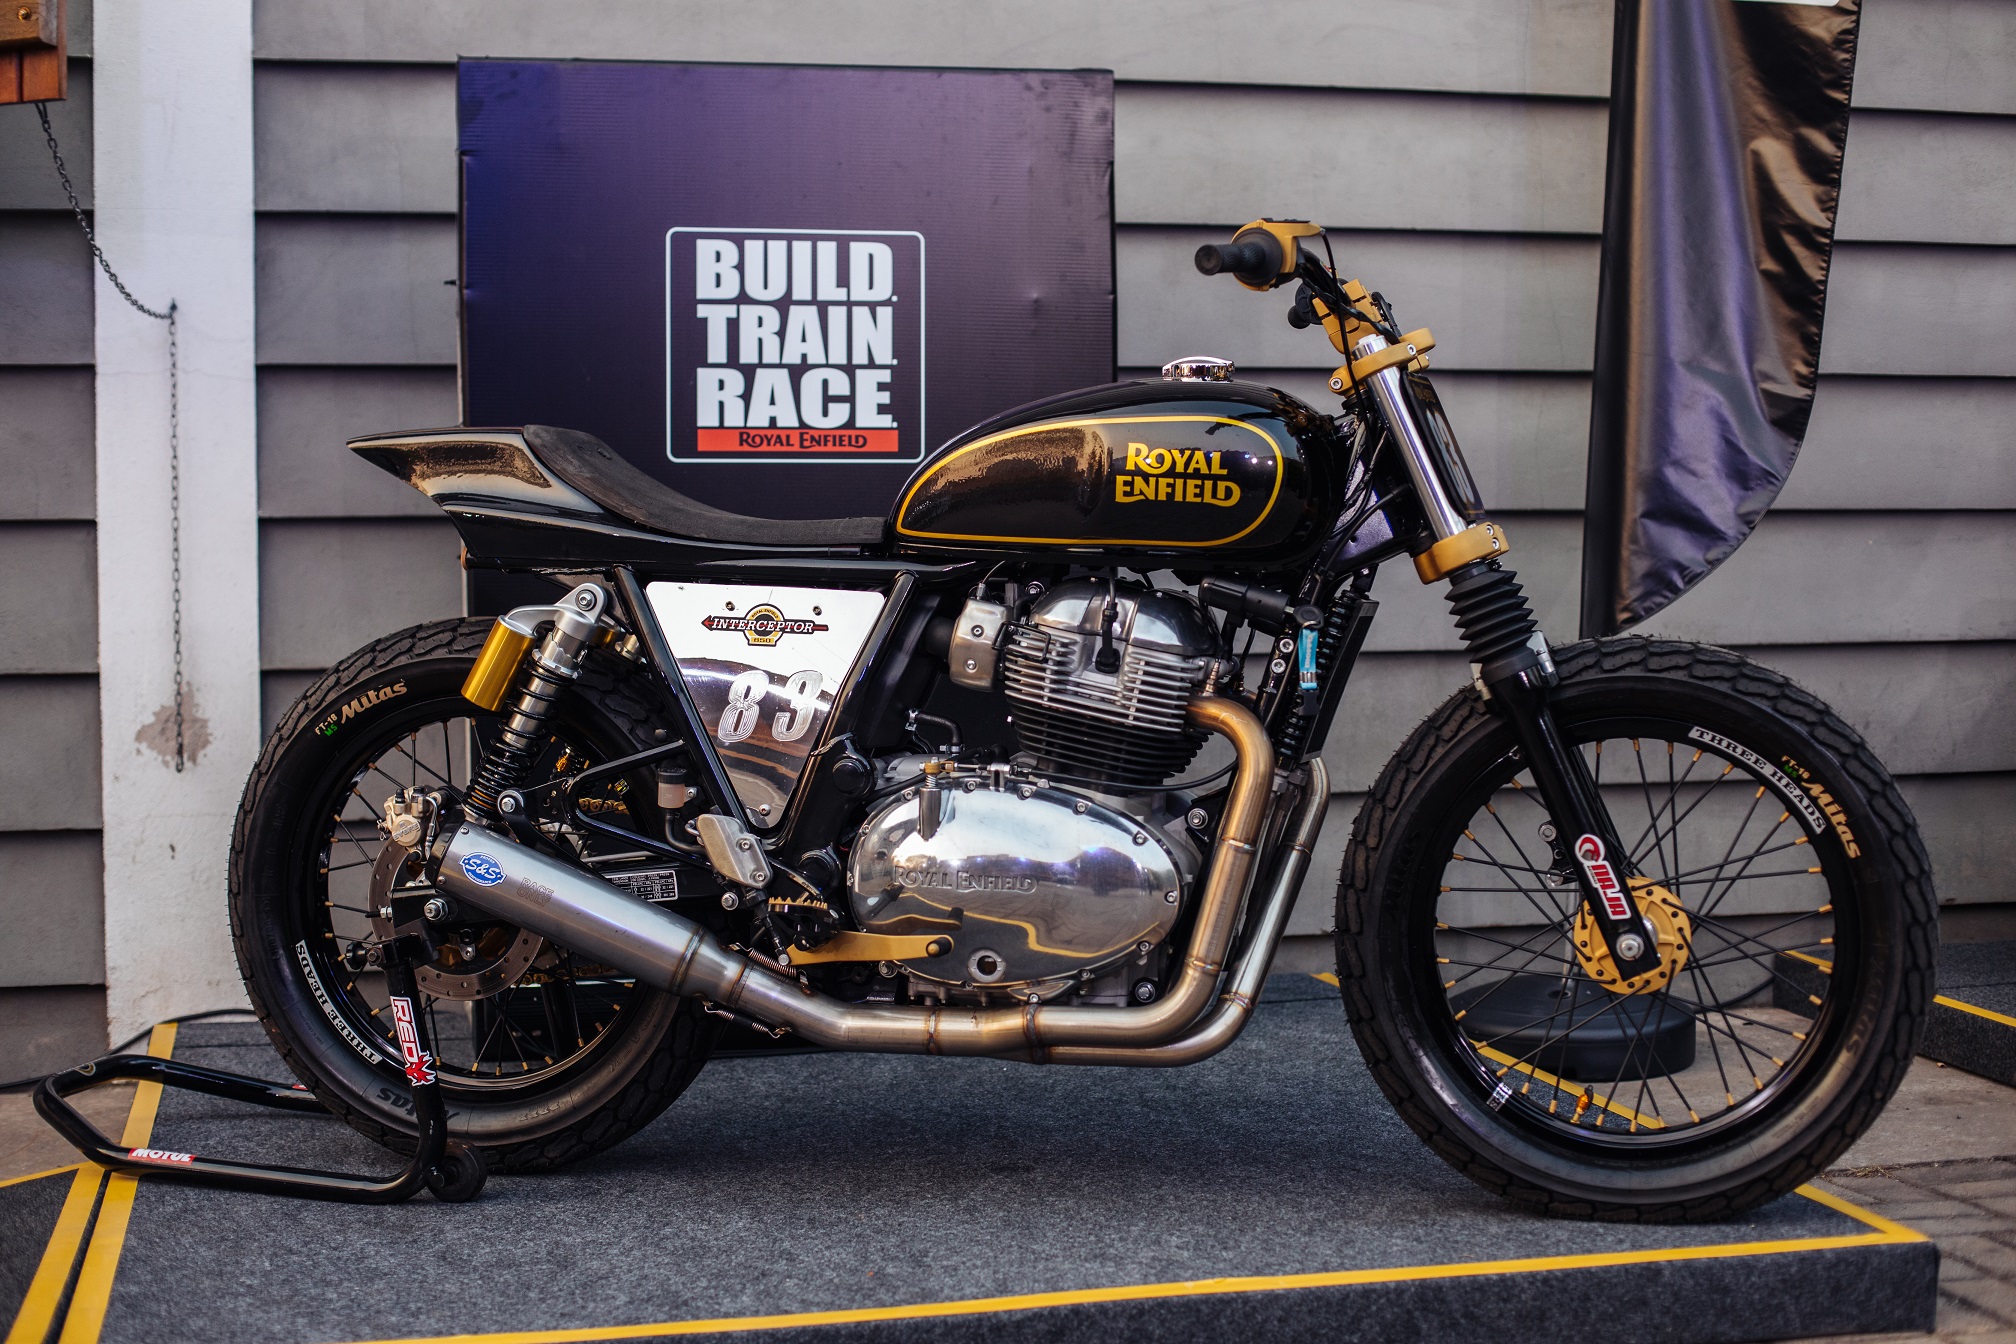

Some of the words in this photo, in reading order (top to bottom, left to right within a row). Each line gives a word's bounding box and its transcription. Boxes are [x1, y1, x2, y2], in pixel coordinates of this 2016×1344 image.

[696, 238, 898, 302] BUILD.
[696, 304, 898, 365] TRAIN.
[696, 367, 898, 429] RACE.
[738, 431, 795, 449] ROYAL
[799, 431, 868, 450] ENFIELD
[1125, 442, 1228, 475] ROYAL
[1115, 475, 1241, 507] ENFIELD
[711, 618, 814, 633] INTERCEPTOR
[341, 680, 408, 724] Mitas
[314, 713, 338, 736] FT-18
[324, 723, 338, 737] MS
[1695, 728, 1768, 770] THREE
[1768, 769, 1826, 830] HEADS
[1781, 755, 1811, 780] FT-18
[1801, 781, 1862, 859] Mitas
[465, 858, 501, 879] S&S
[893, 866, 952, 889] ROYAL
[956, 871, 1038, 894] ENFIELD
[516, 886, 550, 907] ONLY
[521, 877, 554, 898] RACE
[296, 944, 330, 1006] HEADS
[327, 1008, 377, 1063] THREE
[132, 1148, 192, 1162] MOTUL
